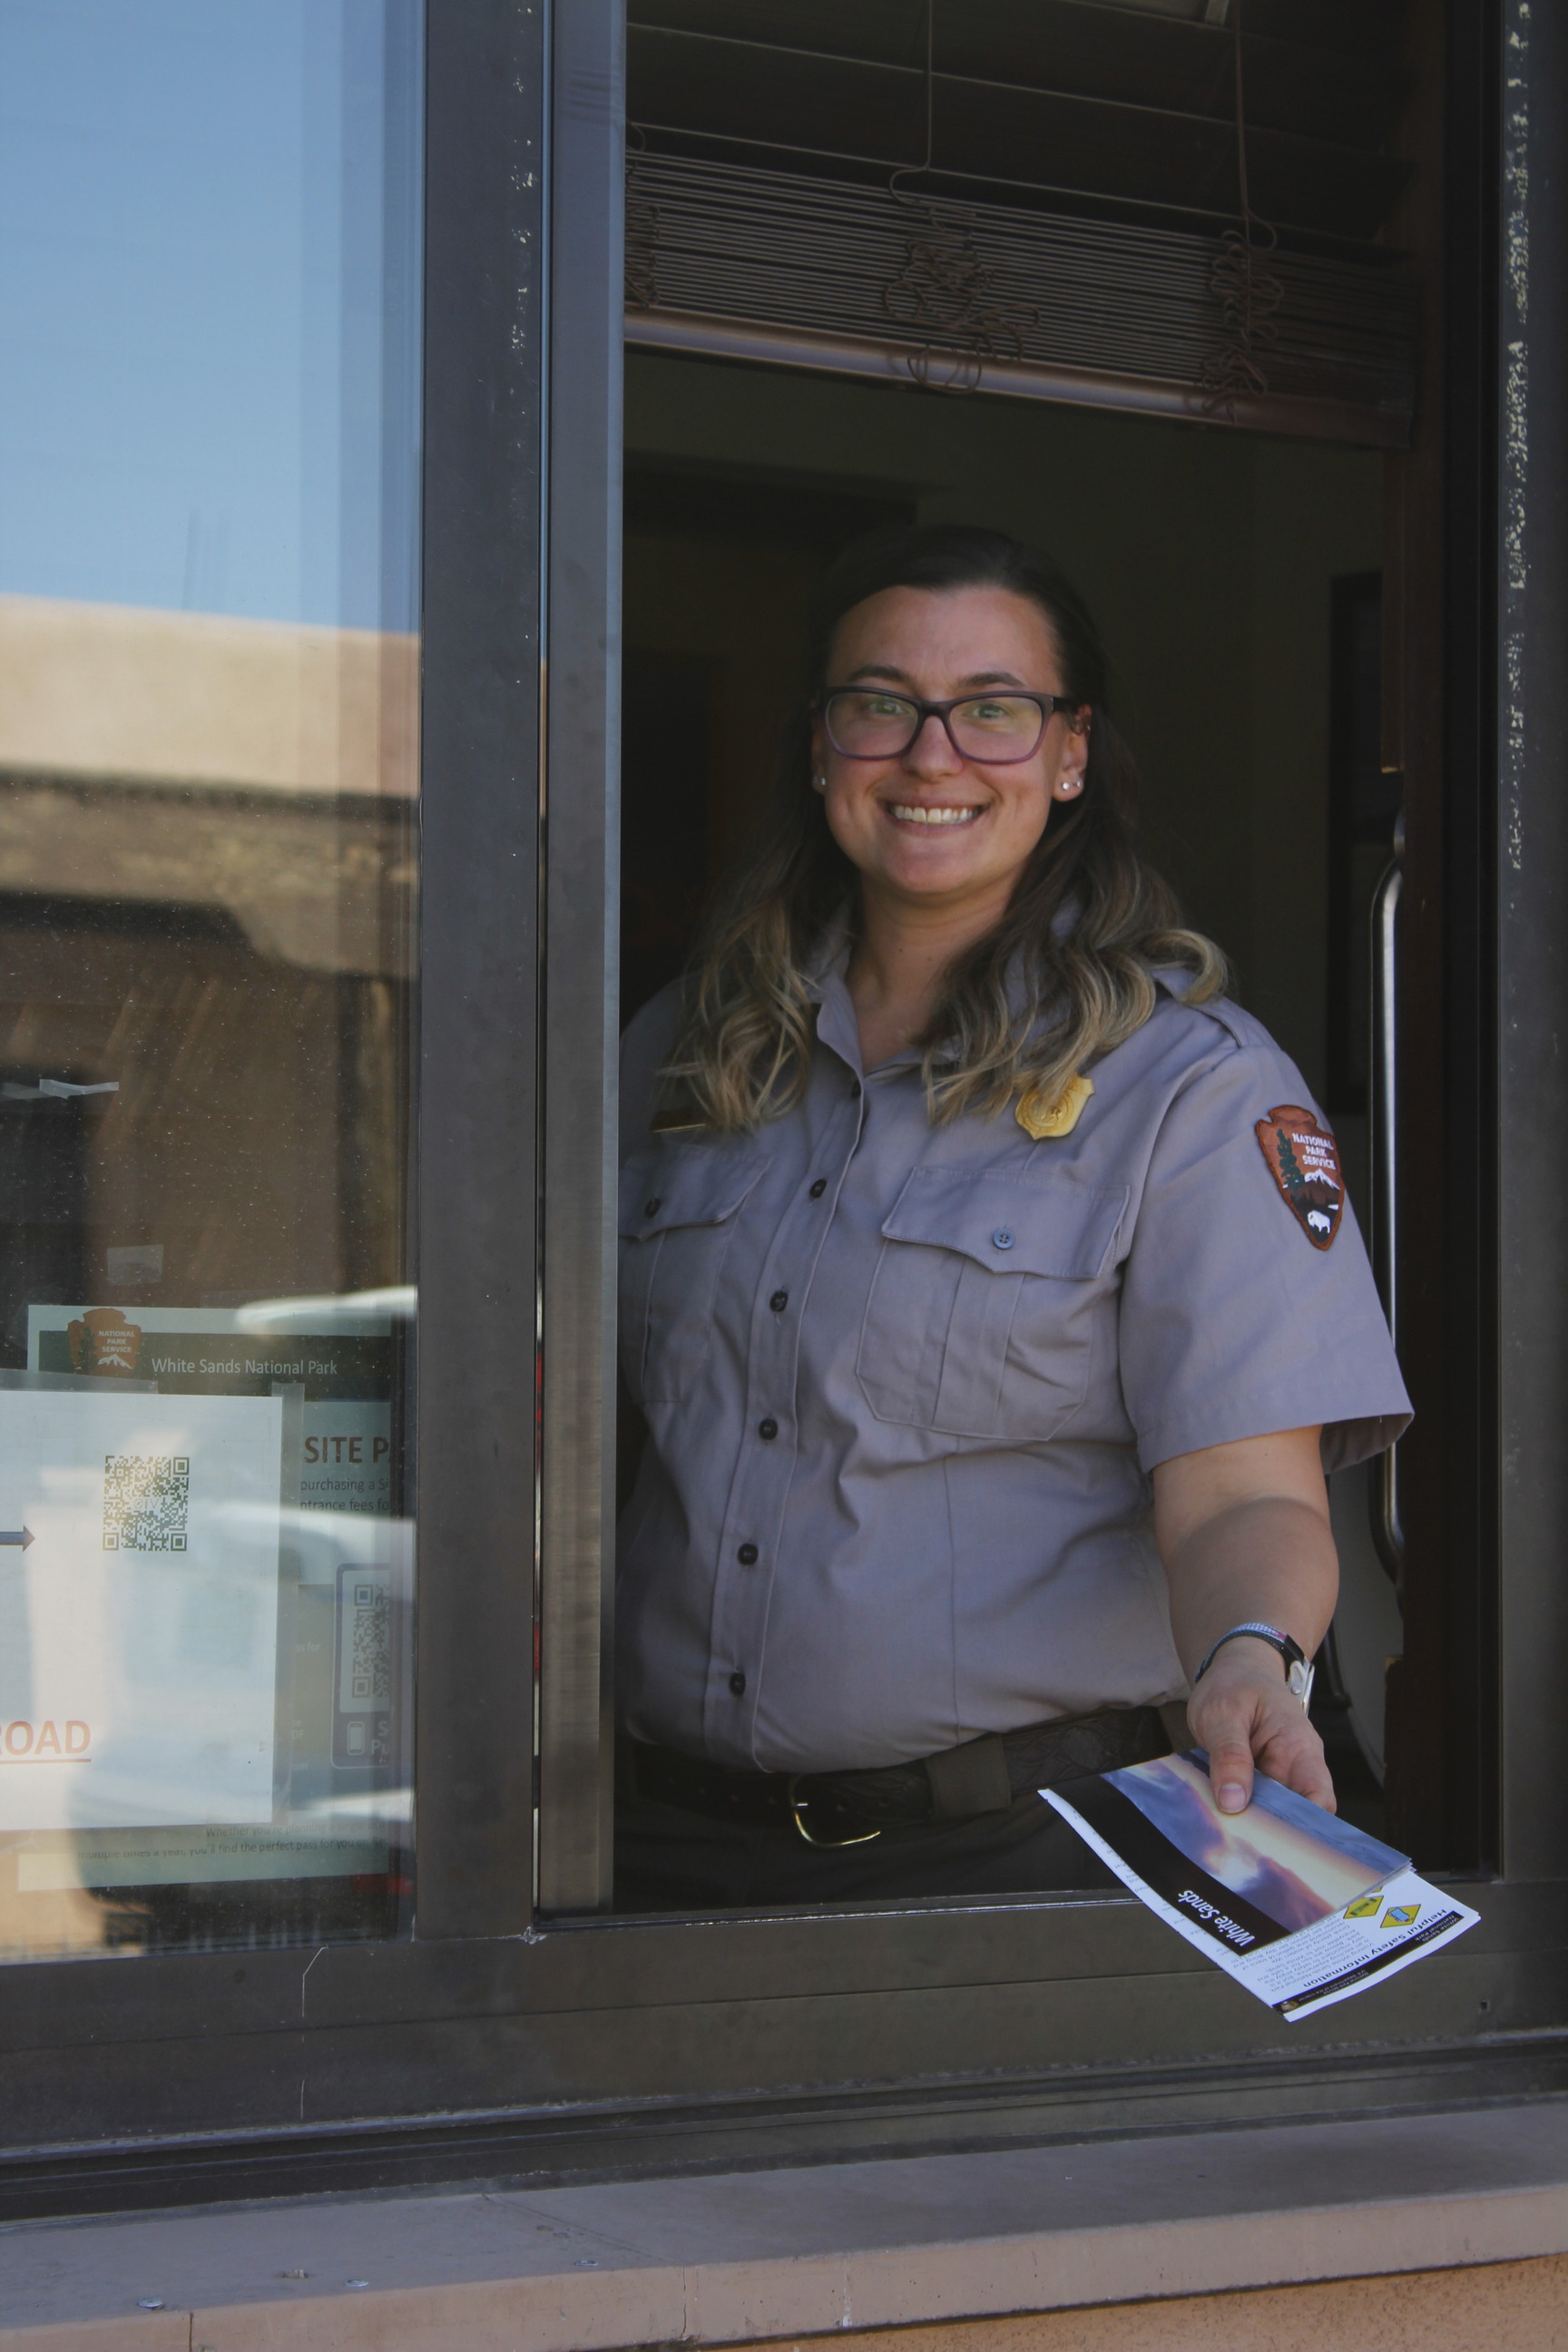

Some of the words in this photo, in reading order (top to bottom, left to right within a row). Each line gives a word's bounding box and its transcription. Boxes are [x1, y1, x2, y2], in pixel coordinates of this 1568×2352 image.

[1291, 1132, 1334, 1151] NATIONAL
[1305, 1145, 1328, 1157] PARK
[1302, 1154, 1337, 1171] SERVICE
[98, 1329, 135, 1338] NATIONAL
[101, 1346, 132, 1354] SERVICE
[152, 1357, 195, 1374] White
[199, 1357, 240, 1374] Sands
[245, 1359, 301, 1375] National
[308, 1360, 338, 1376] Park
[304, 1436, 362, 1464] SITE
[372, 1436, 390, 1464] P
[300, 1477, 365, 1494] purchasing
[368, 1480, 376, 1491] a
[349, 1498, 374, 1511] fees
[0, 1720, 90, 1755] OAD
[206, 1827, 250, 1838] Whether
[218, 1842, 238, 1854] find
[240, 1842, 257, 1853] the
[260, 1840, 294, 1854] perfect
[297, 1841, 318, 1852] pass
[319, 1838, 335, 1849] for
[1178, 1889, 1220, 1919] Sands
[1214, 1913, 1256, 1948] White
[1406, 1908, 1447, 1936] Helpful
[1370, 1934, 1406, 1955] Safety
[1303, 1955, 1370, 1987] Information
